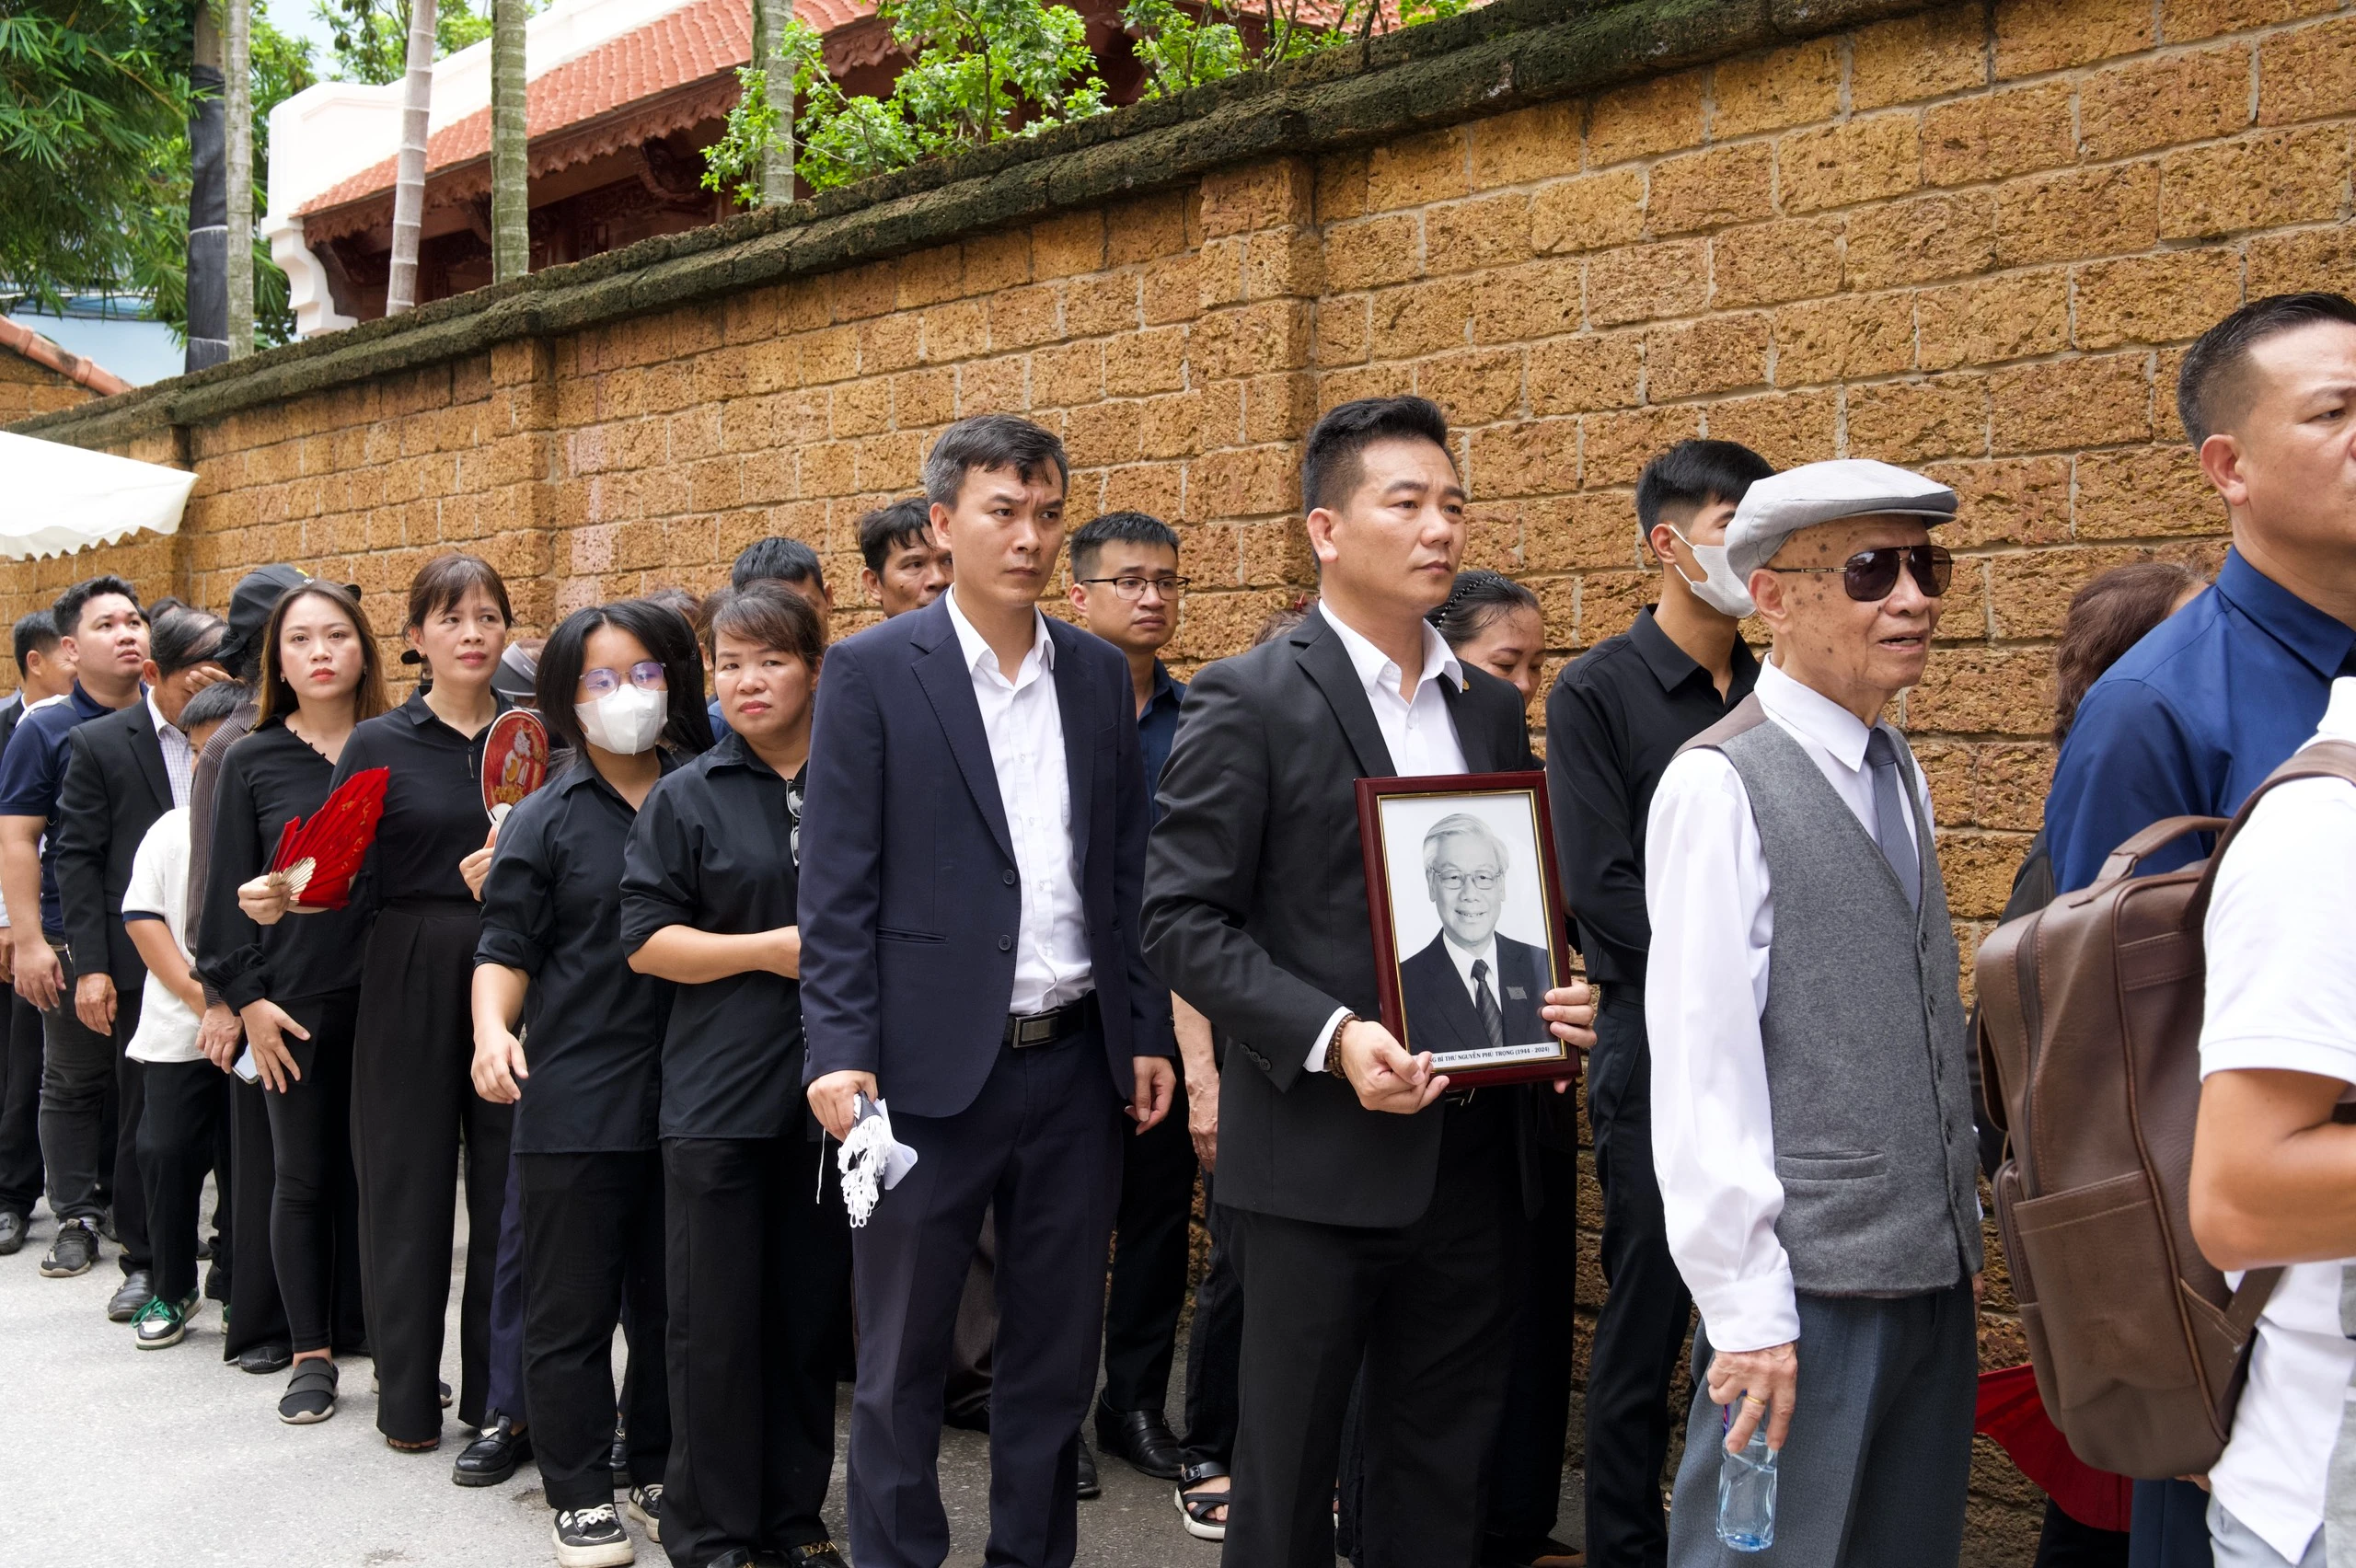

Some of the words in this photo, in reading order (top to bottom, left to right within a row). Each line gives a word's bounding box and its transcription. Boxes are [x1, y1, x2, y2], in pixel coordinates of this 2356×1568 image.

[1458, 1051, 1481, 1060] NGUYỄN
[1495, 1049, 1515, 1057] TRỌNG
[1515, 1047, 1530, 1055] (1944
